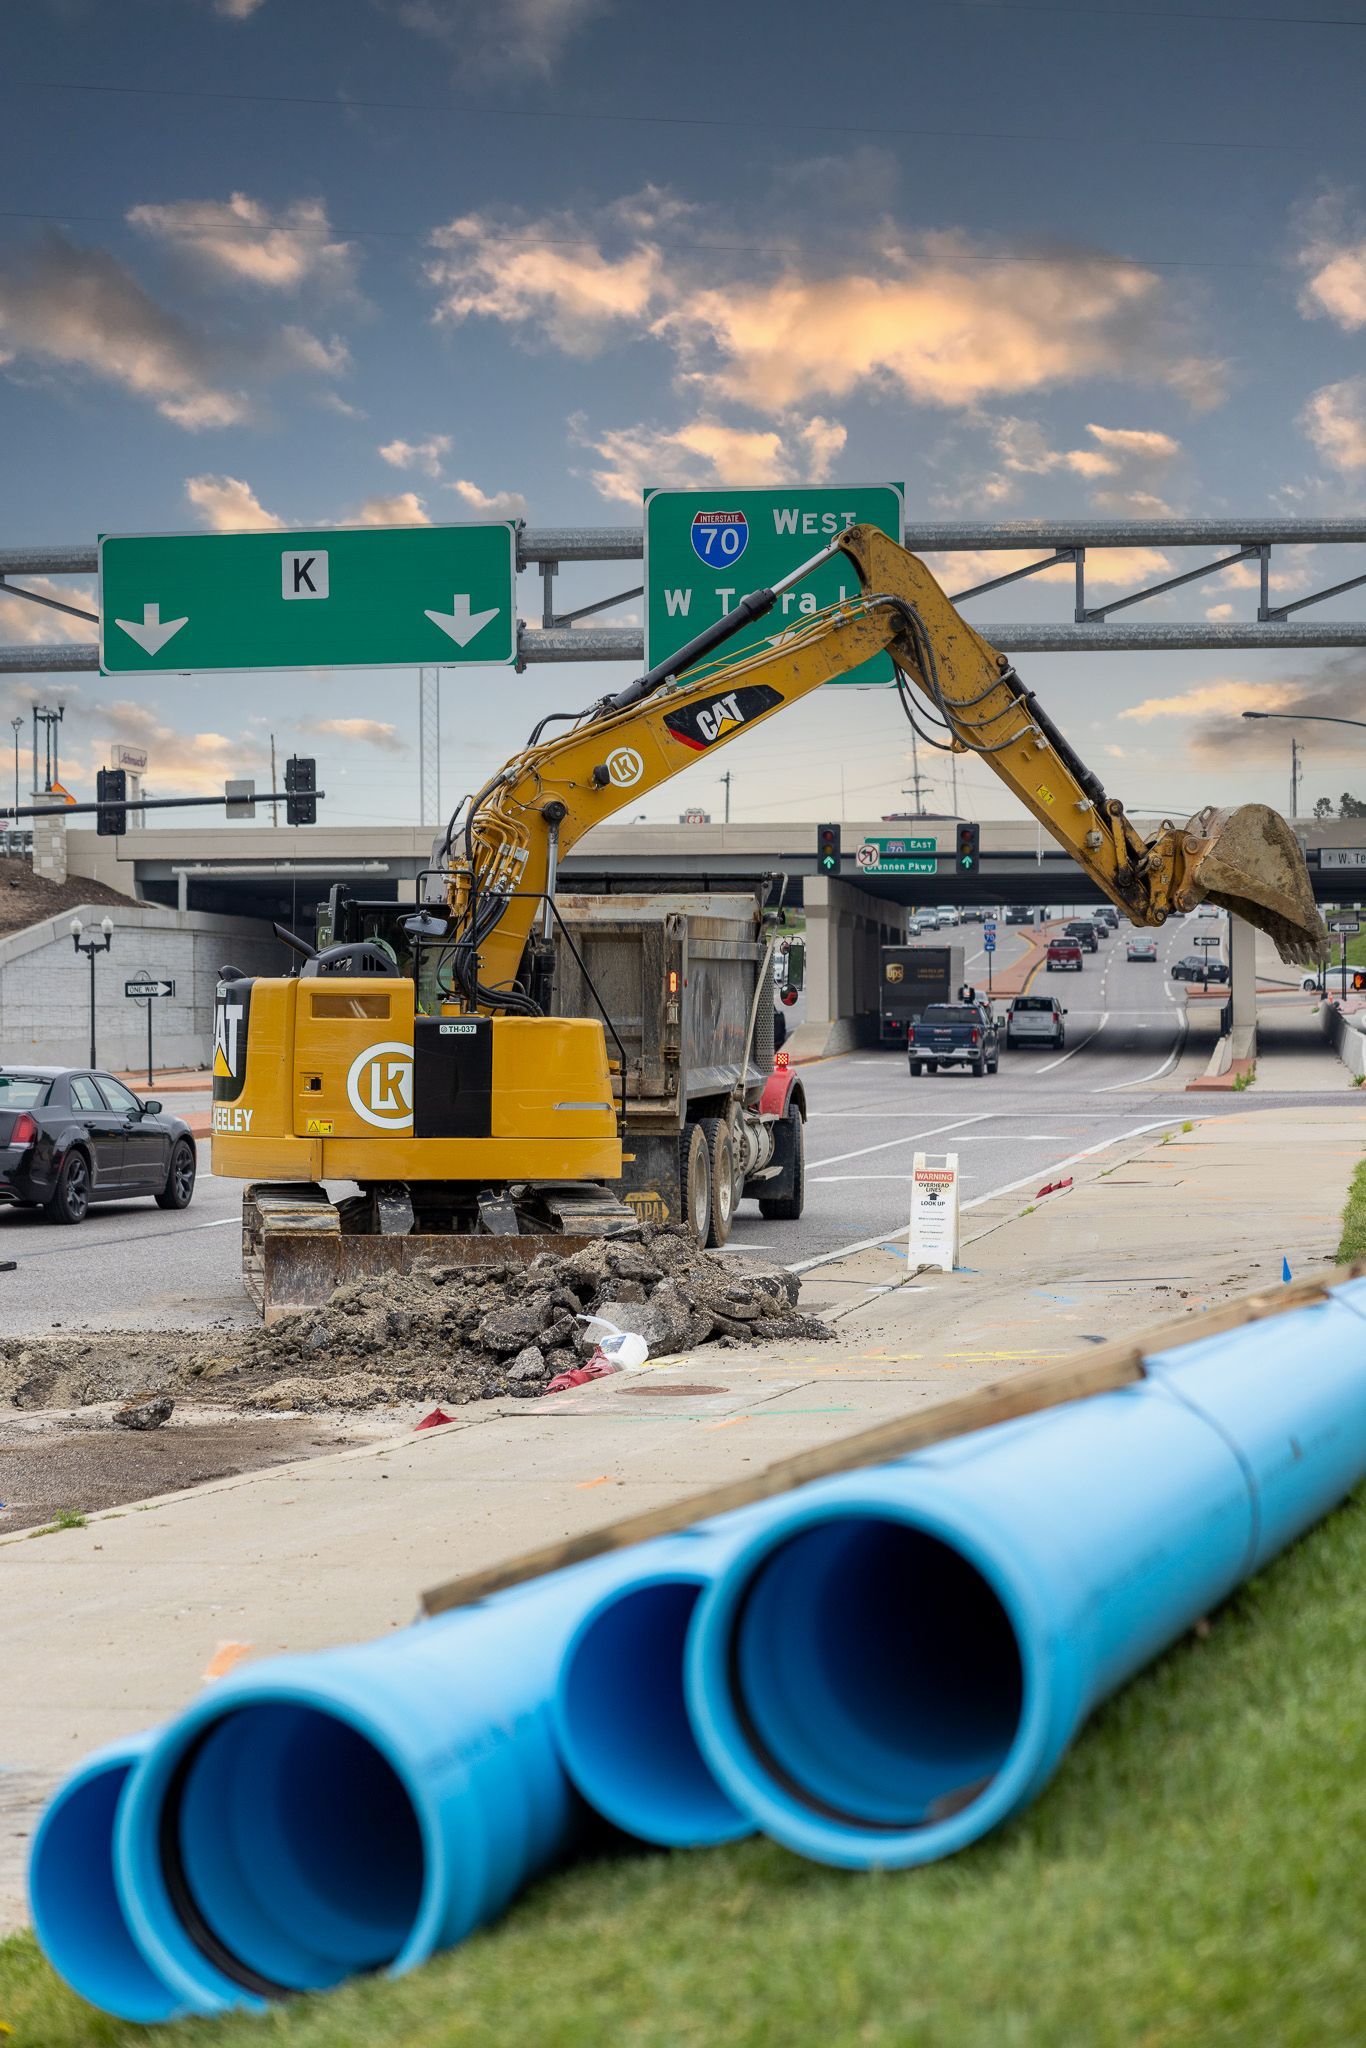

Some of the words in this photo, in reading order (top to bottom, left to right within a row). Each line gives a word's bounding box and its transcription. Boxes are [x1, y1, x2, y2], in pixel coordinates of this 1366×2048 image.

[700, 514, 740, 524] INTERSTATE
[773, 509, 857, 535] WEST
[700, 528, 740, 555] 70
[293, 558, 317, 593] K
[664, 589, 692, 617] W
[696, 693, 745, 741] CAT
[910, 840, 932, 849] EAST
[908, 862, 933, 872] Pkwy
[1338, 852, 1351, 864] W.
[888, 969, 902, 980] ups
[213, 1005, 244, 1077] AT
[916, 1172, 953, 1181] WARNING
